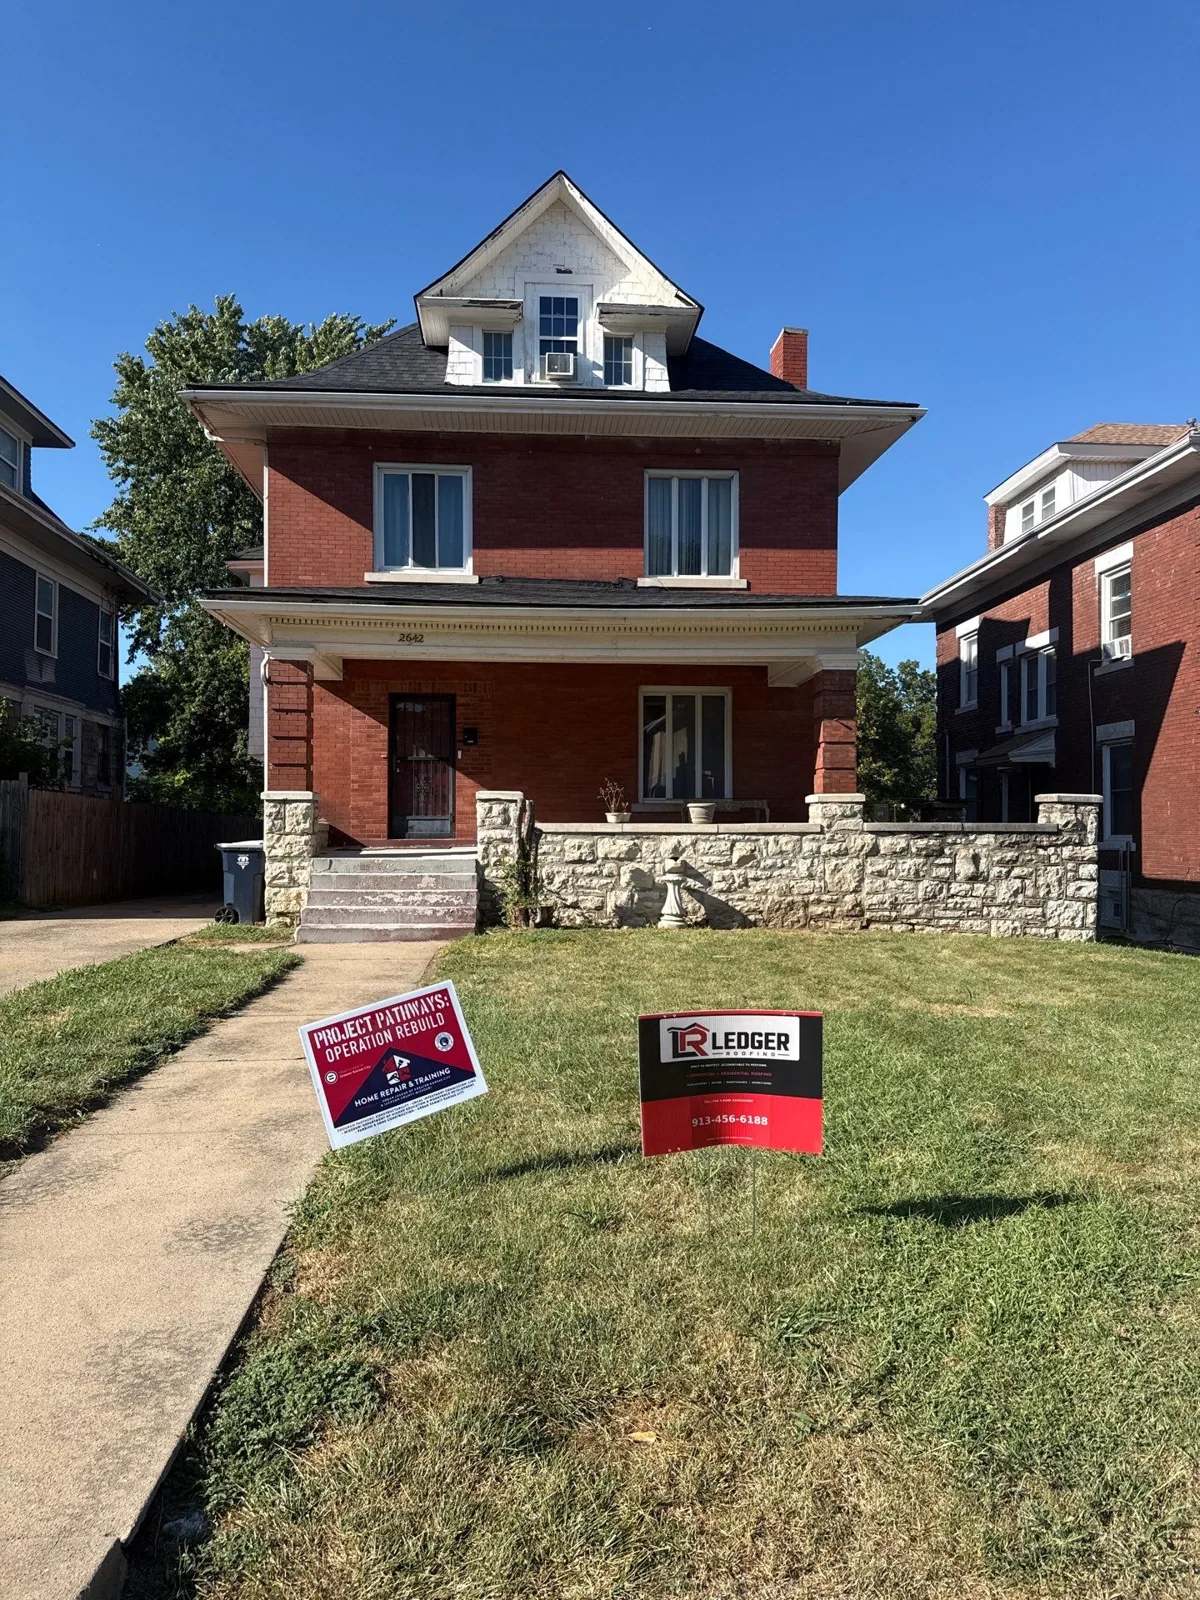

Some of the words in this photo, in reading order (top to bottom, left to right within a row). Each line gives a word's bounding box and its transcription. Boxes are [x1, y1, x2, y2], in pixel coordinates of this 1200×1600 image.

[398, 633, 424, 643] 2642
[313, 1016, 373, 1048] PROJECT
[375, 993, 449, 1028] PATHWAYS:
[325, 1030, 393, 1062] OPERATION
[396, 1013, 445, 1039] REBUILD
[711, 1031, 790, 1051] LEDGER
[354, 1093, 379, 1107] HOME
[380, 1083, 407, 1097] REPAIR
[415, 1067, 450, 1085] TRAINING
[692, 1114, 769, 1127] 913-456-6188
